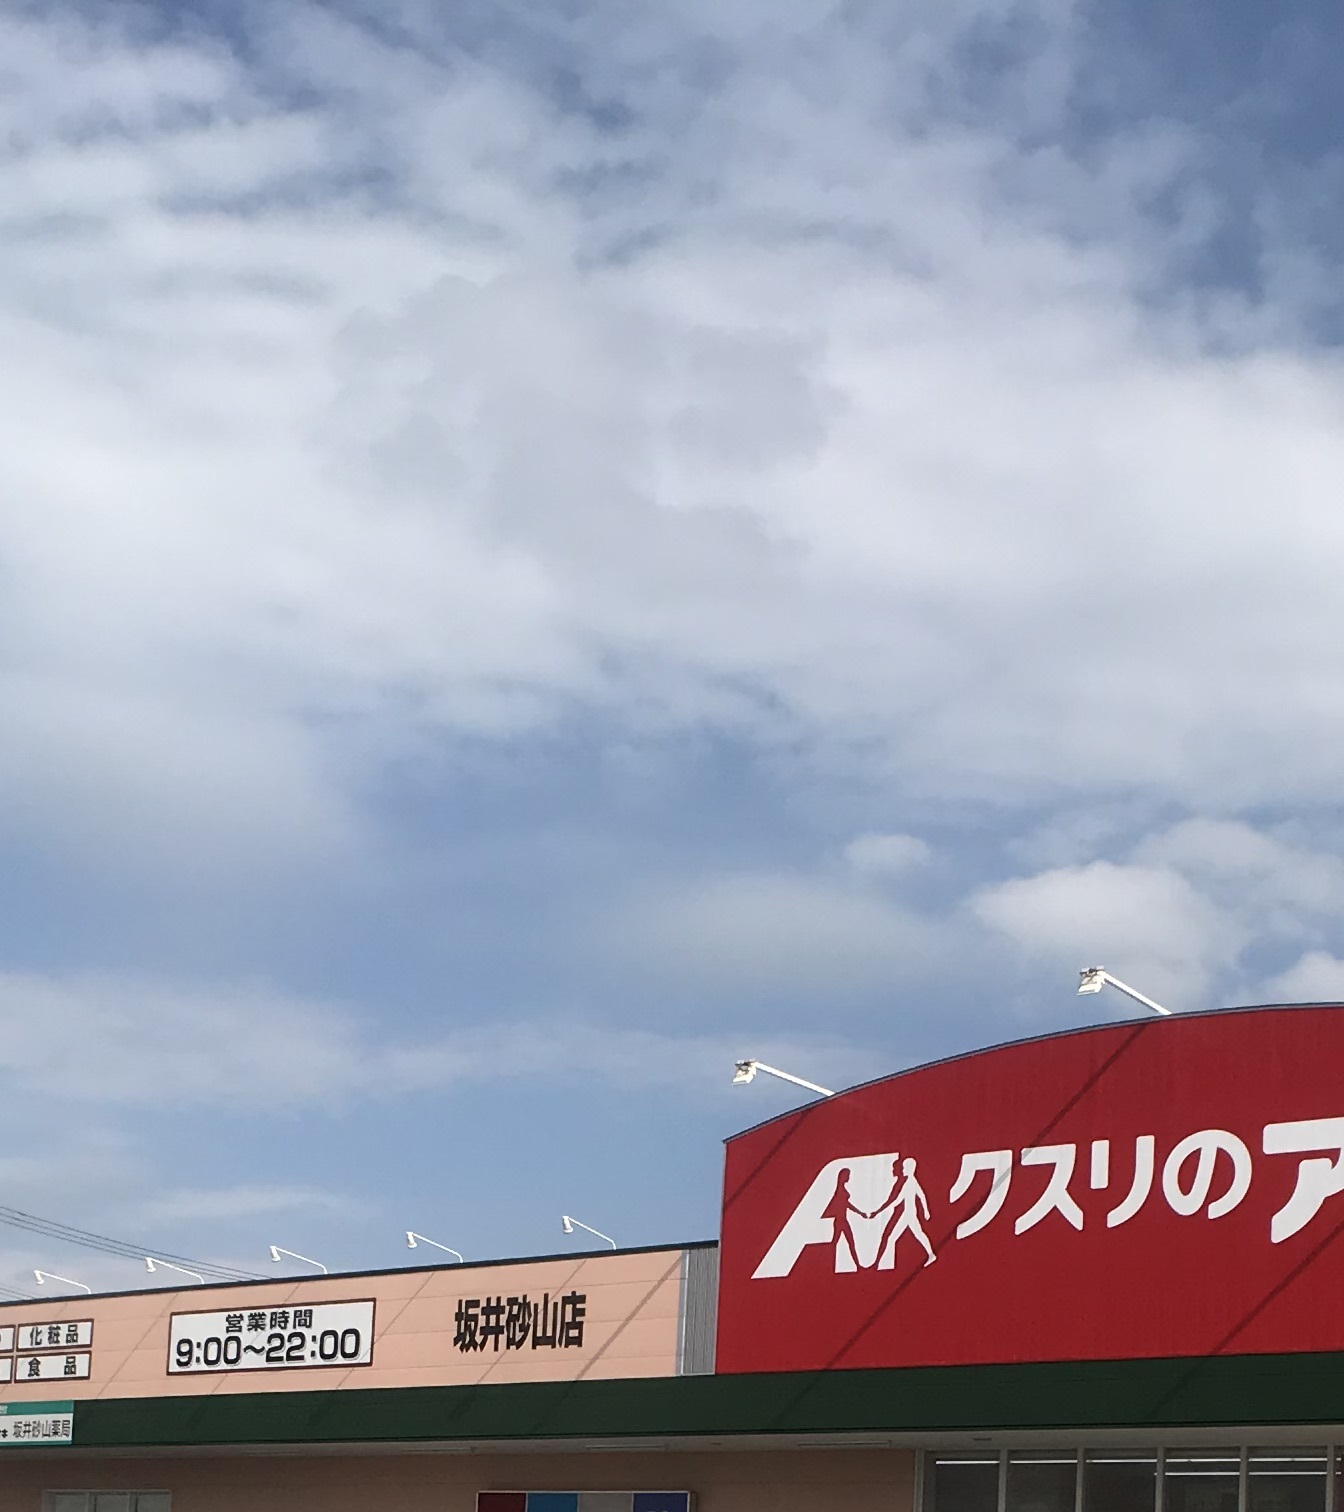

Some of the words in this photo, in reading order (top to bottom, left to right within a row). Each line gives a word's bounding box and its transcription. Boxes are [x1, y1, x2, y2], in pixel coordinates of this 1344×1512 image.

[225, 1309, 313, 1333] 営業時間
[453, 1290, 587, 1353] 坂井砂山店
[29, 1324, 79, 1347] 化粧品
